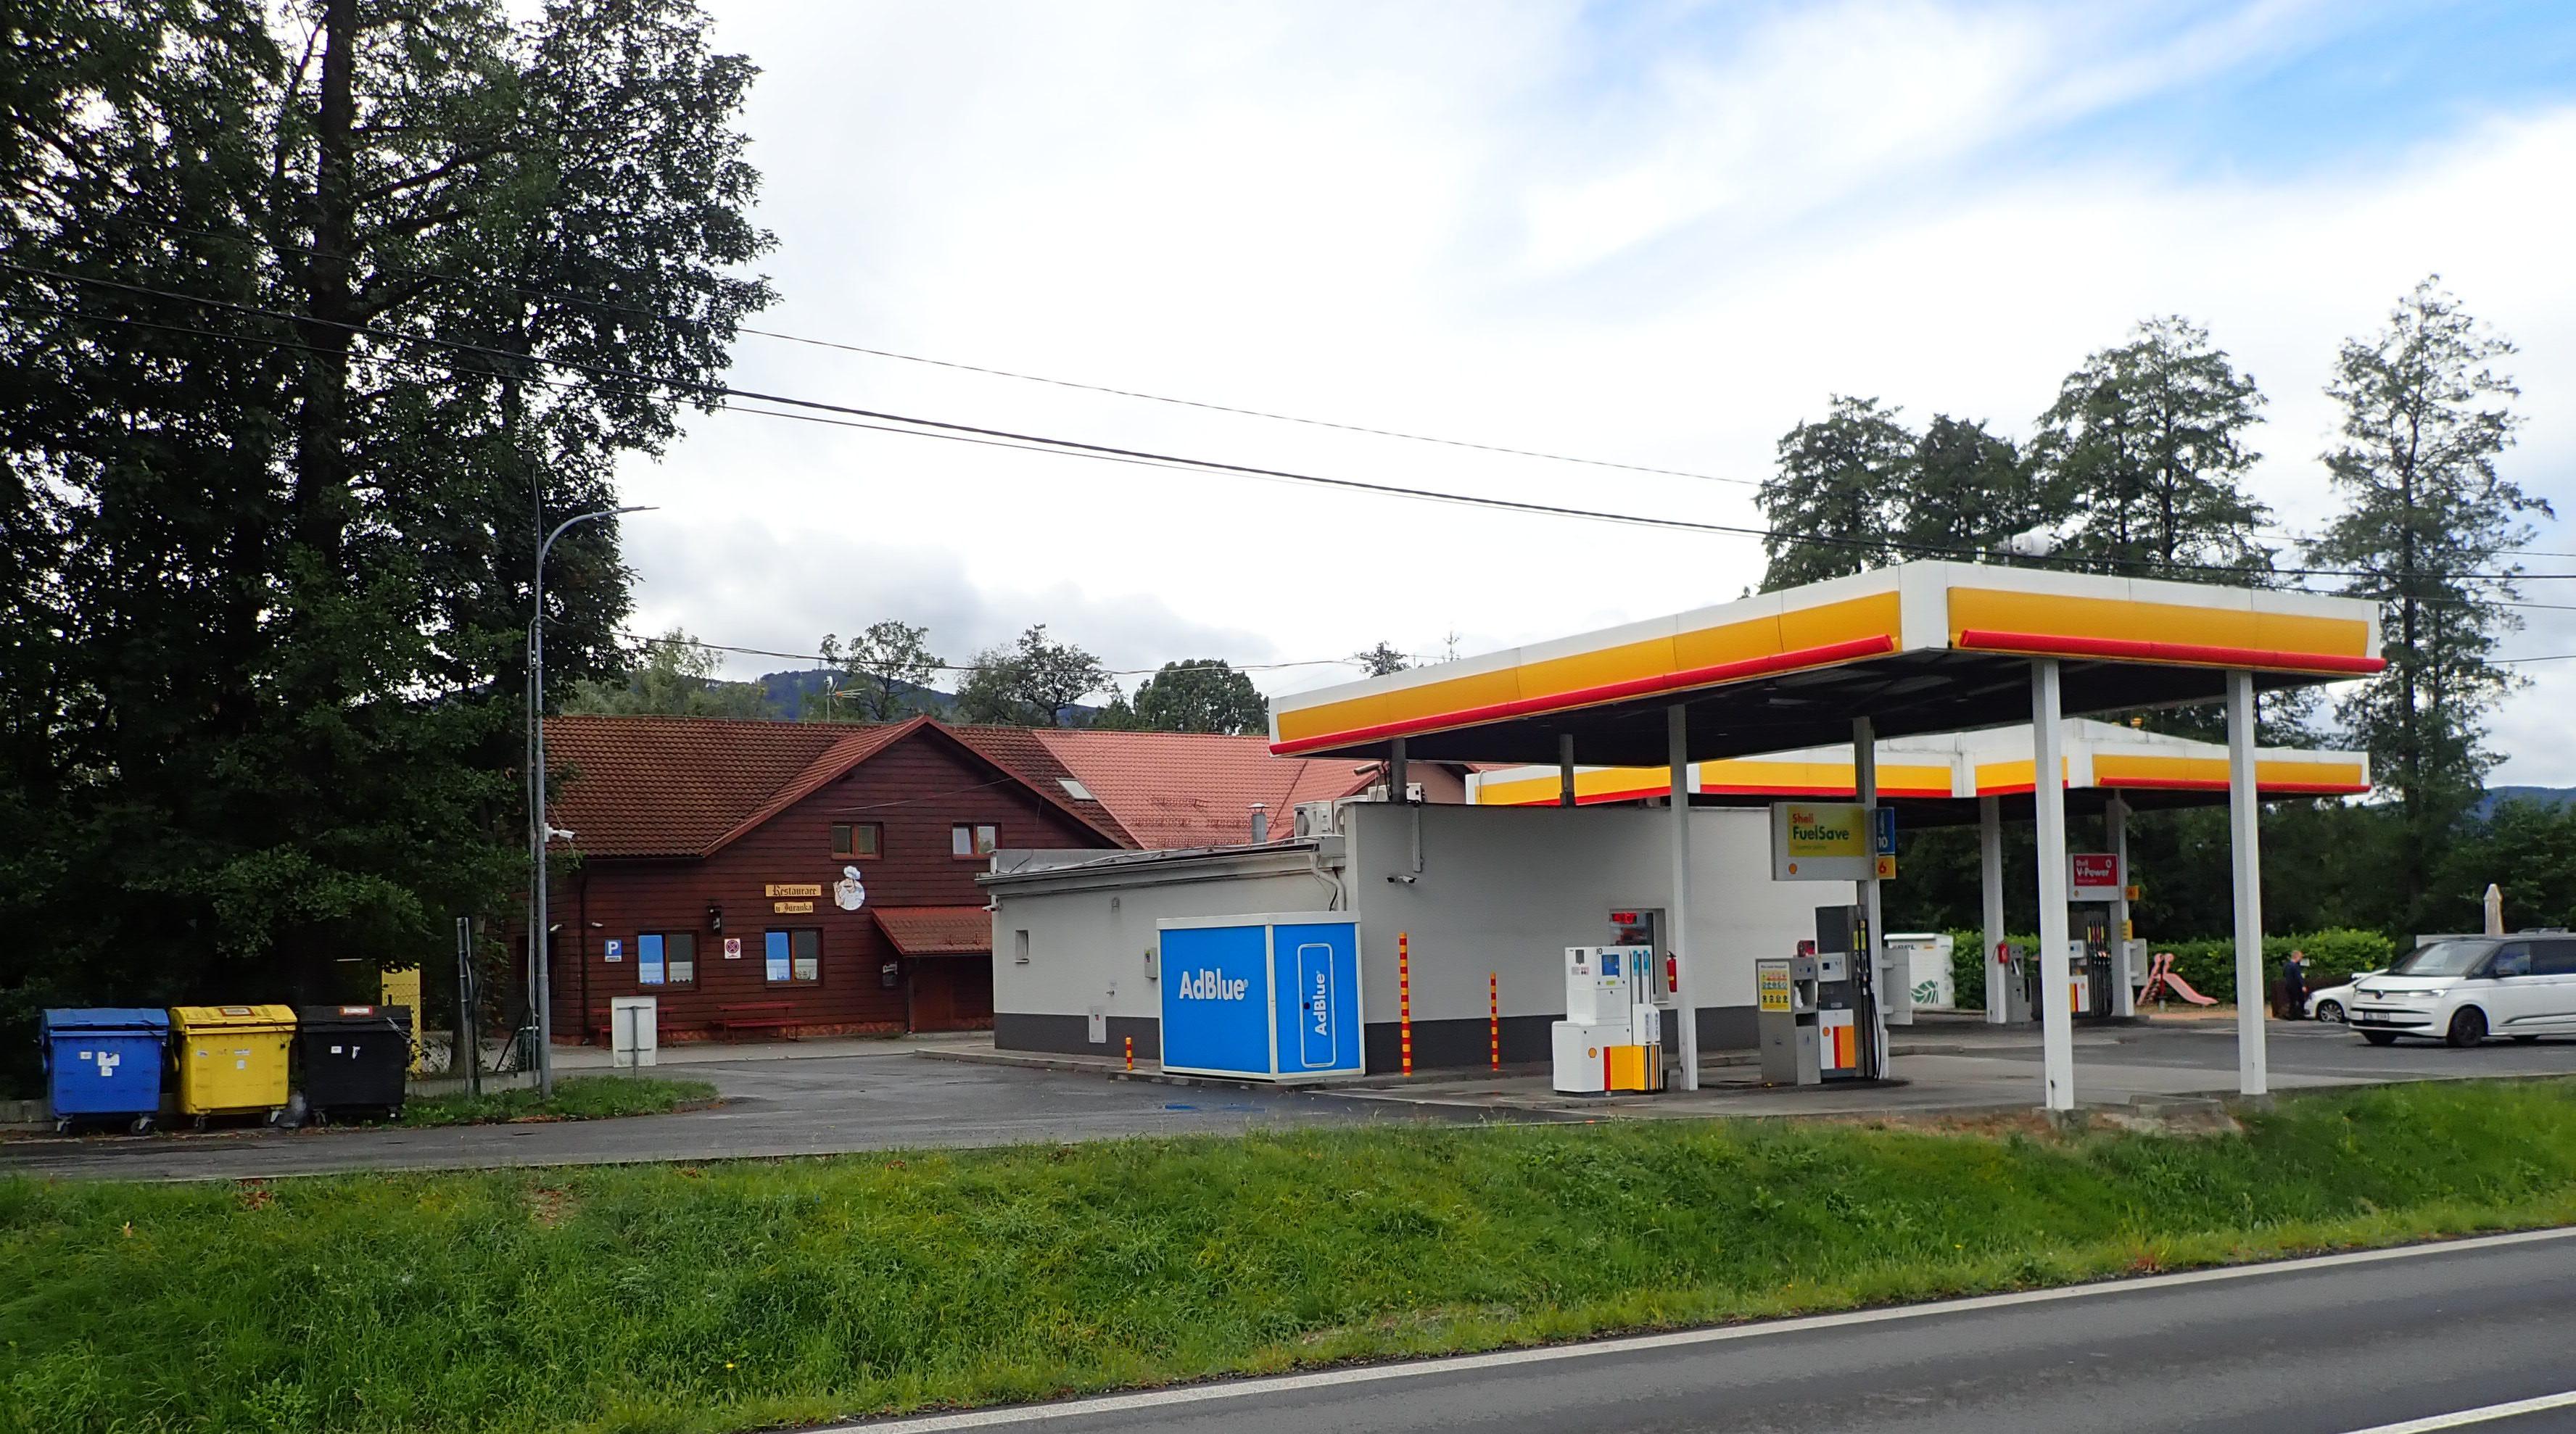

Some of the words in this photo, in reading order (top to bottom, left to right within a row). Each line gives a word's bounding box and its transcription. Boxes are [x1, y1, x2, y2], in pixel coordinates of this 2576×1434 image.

[1793, 813, 1815, 824] Shell
[1793, 826, 1849, 840] FuelSave
[1878, 837, 1888, 847] 10
[1878, 861, 1887, 874] 6
[772, 884, 817, 896] Restaurace
[608, 941, 619, 955] P
